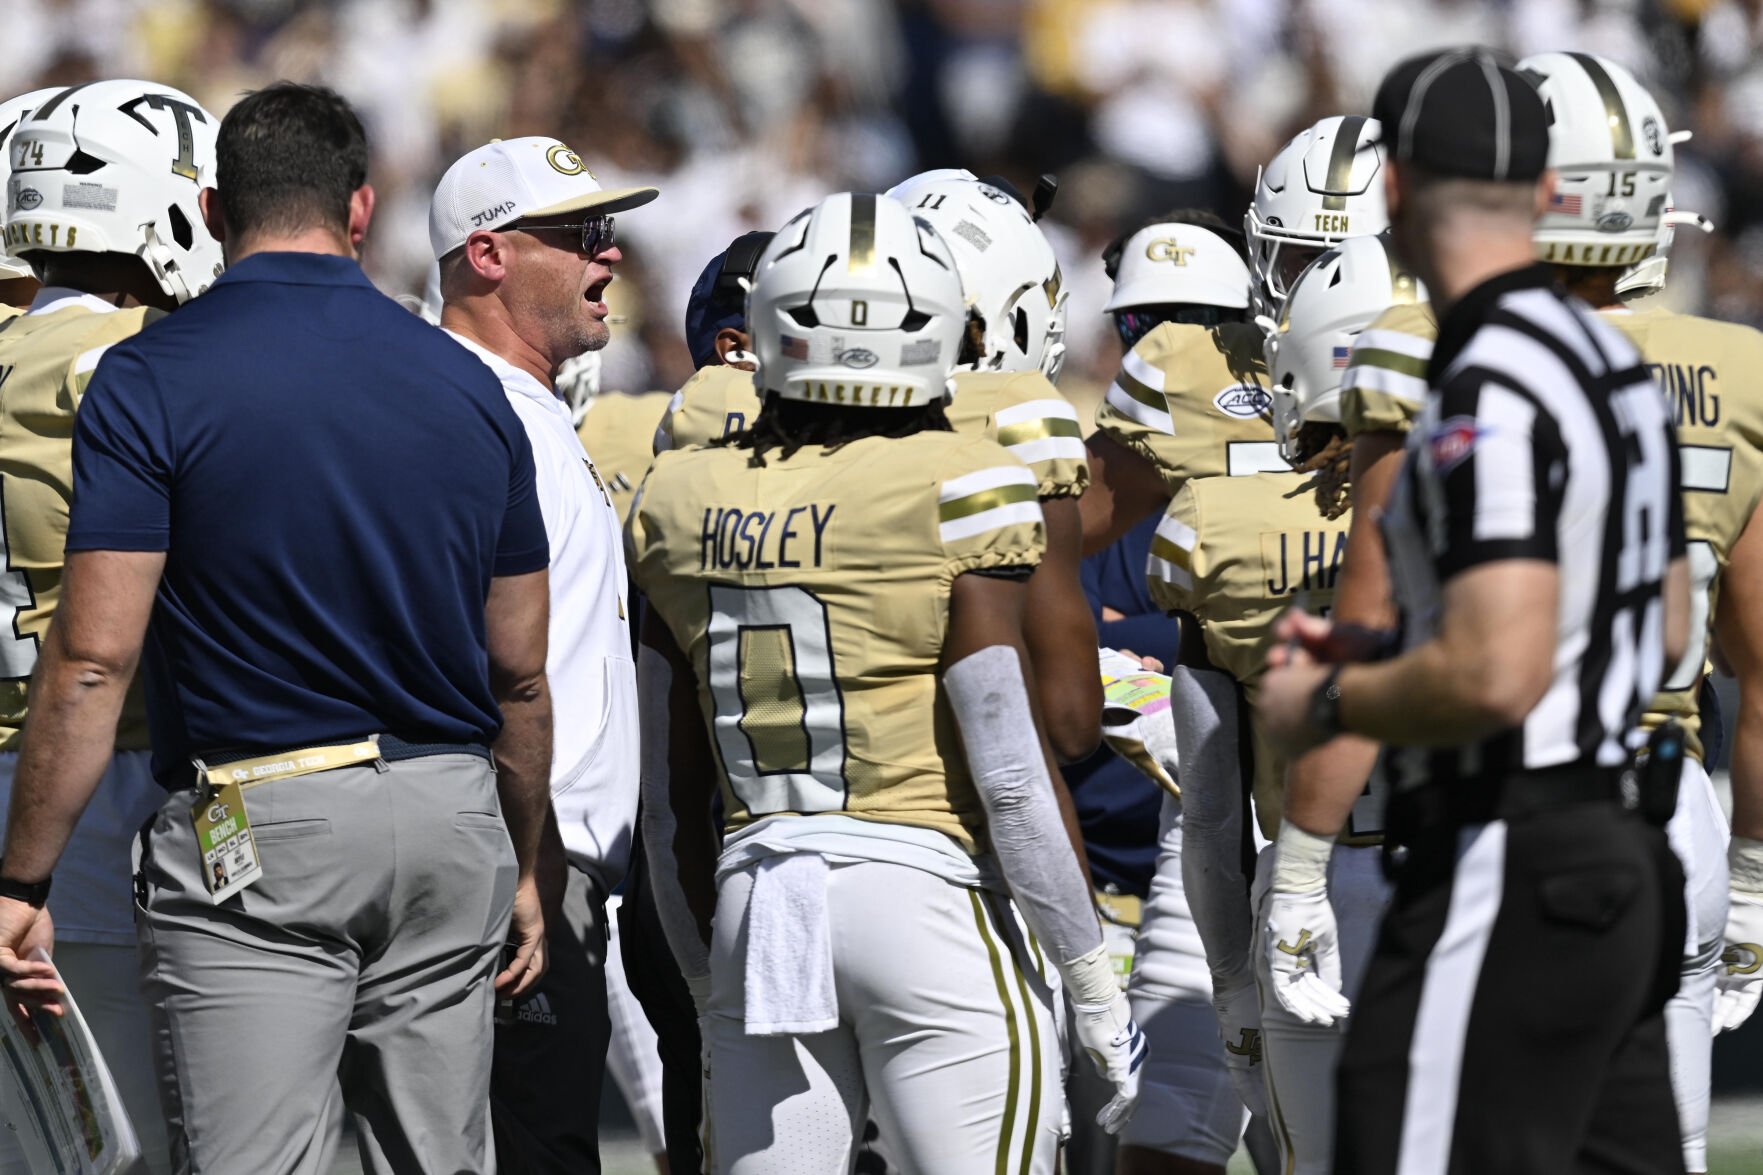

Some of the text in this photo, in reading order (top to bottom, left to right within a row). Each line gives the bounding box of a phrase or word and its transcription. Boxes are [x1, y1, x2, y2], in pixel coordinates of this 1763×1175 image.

[19, 141, 44, 167] 74
[1607, 170, 1638, 197] 15
[471, 201, 516, 227] JUMP
[916, 193, 947, 210] 11
[1314, 213, 1350, 233] TECH
[1146, 237, 1195, 267] GT
[851, 299, 868, 326] 0
[804, 380, 914, 407] JACKETS
[701, 503, 836, 571] HOSLEY
[705, 582, 849, 817] 0
[207, 802, 230, 824] GT
[208, 817, 238, 845] BENCH
[517, 1009, 558, 1026] adidas
